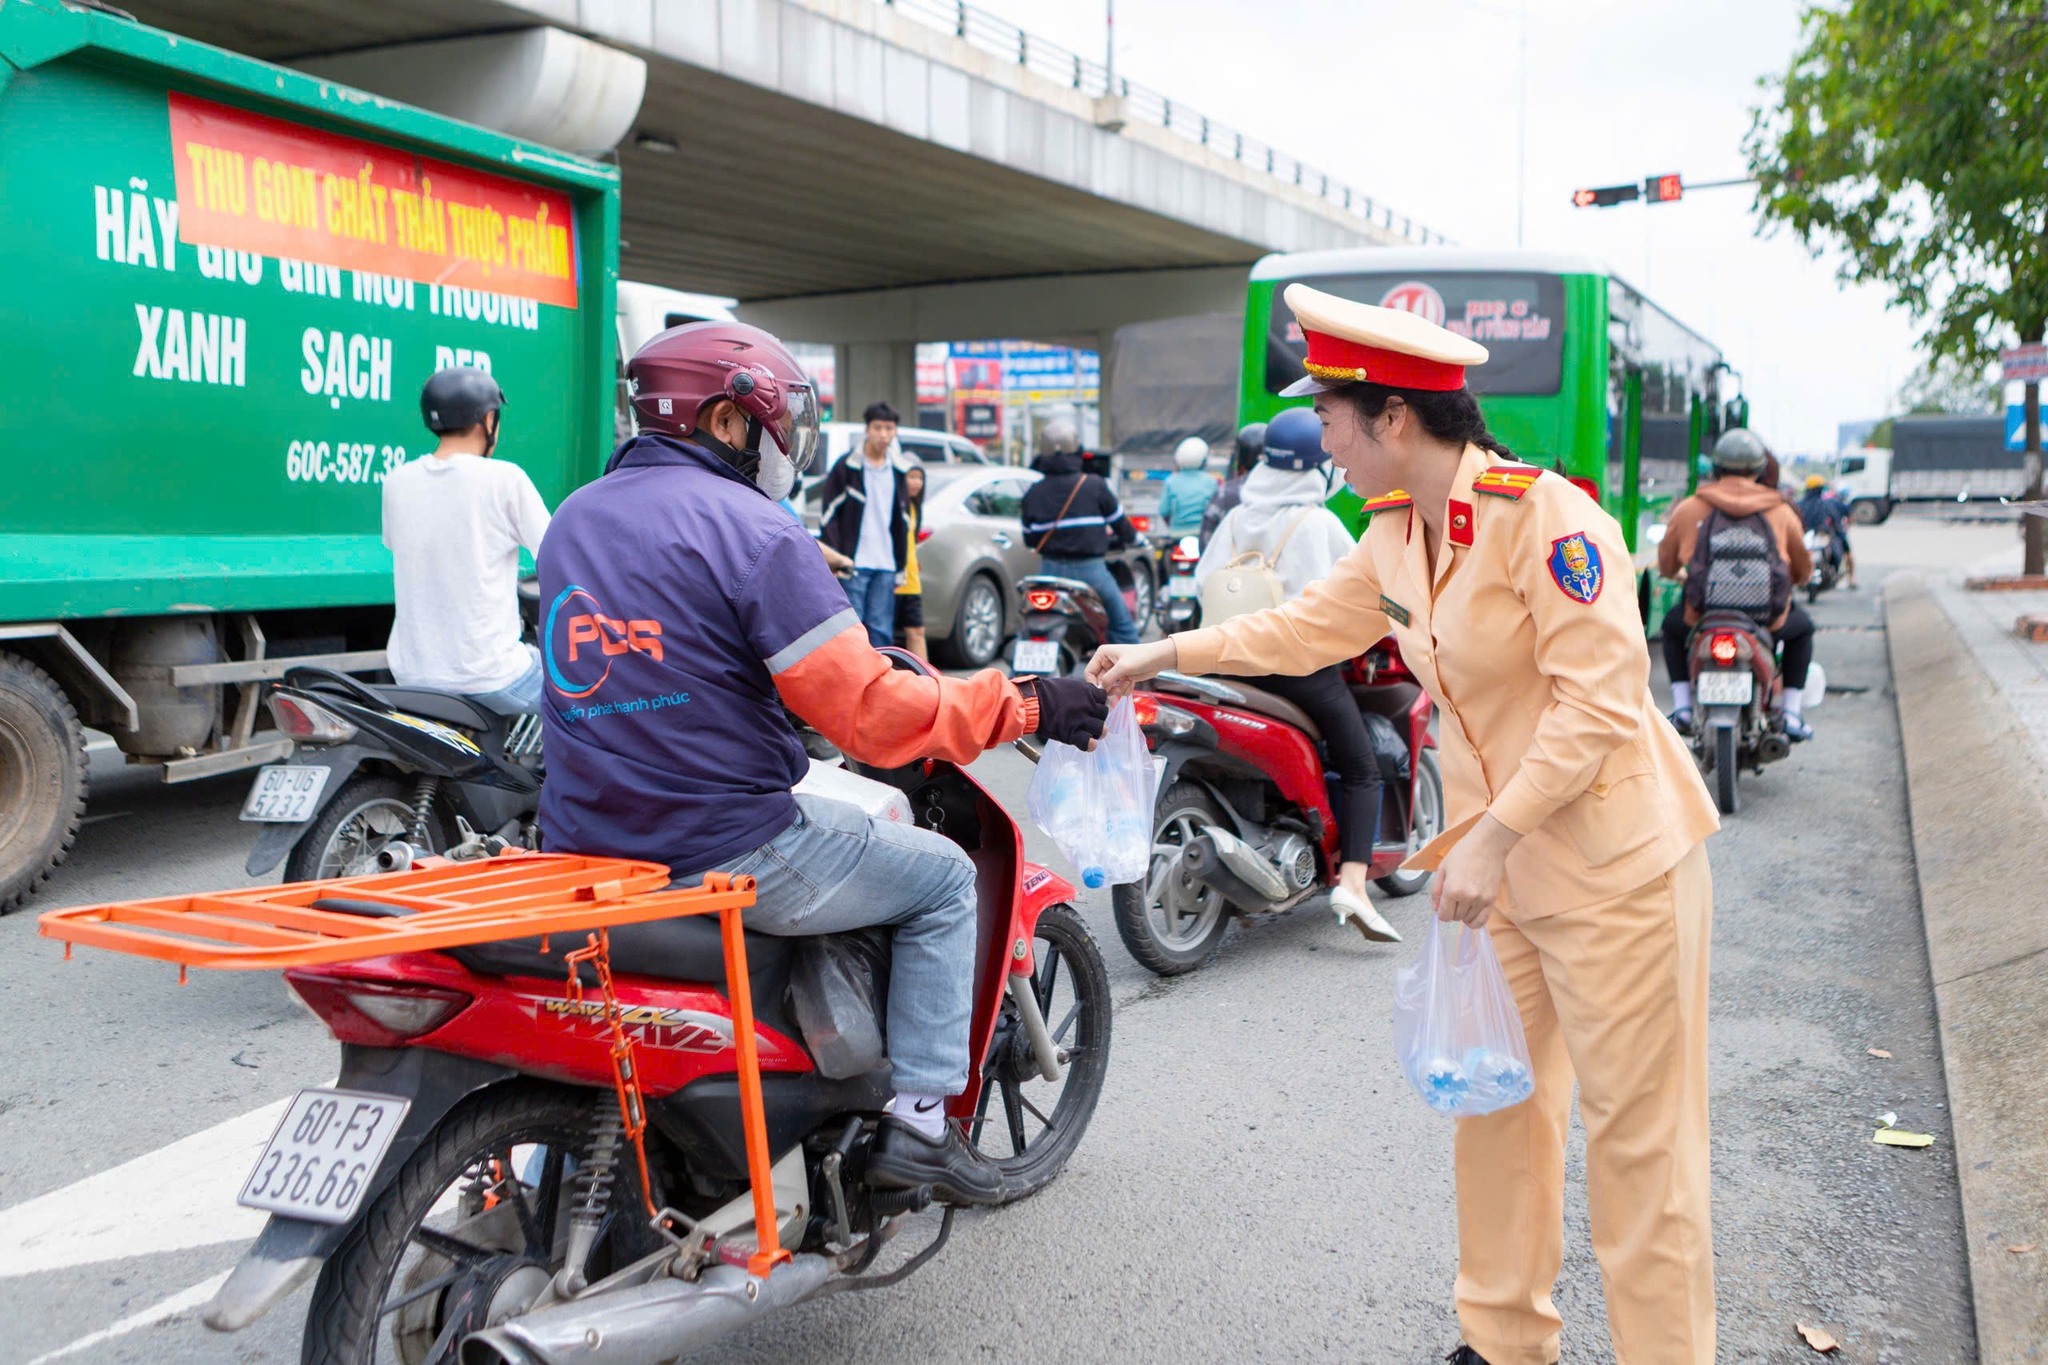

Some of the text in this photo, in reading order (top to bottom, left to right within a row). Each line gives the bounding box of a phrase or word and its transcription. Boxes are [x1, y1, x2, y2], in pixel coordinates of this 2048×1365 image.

[94, 176, 179, 272] HÃY
[186, 141, 570, 280] THU GOM CHẤT THẢI THỰC PHẨM
[132, 302, 393, 410] XANH SẠCH
[568, 613, 664, 662] PCS
[614, 697, 650, 716] hạnh
[652, 691, 690, 711] phúc
[254, 794, 306, 817] 5232
[263, 770, 317, 793] 60-U6
[292, 1099, 384, 1151] 60-F3
[252, 1151, 366, 1209] 336.66
